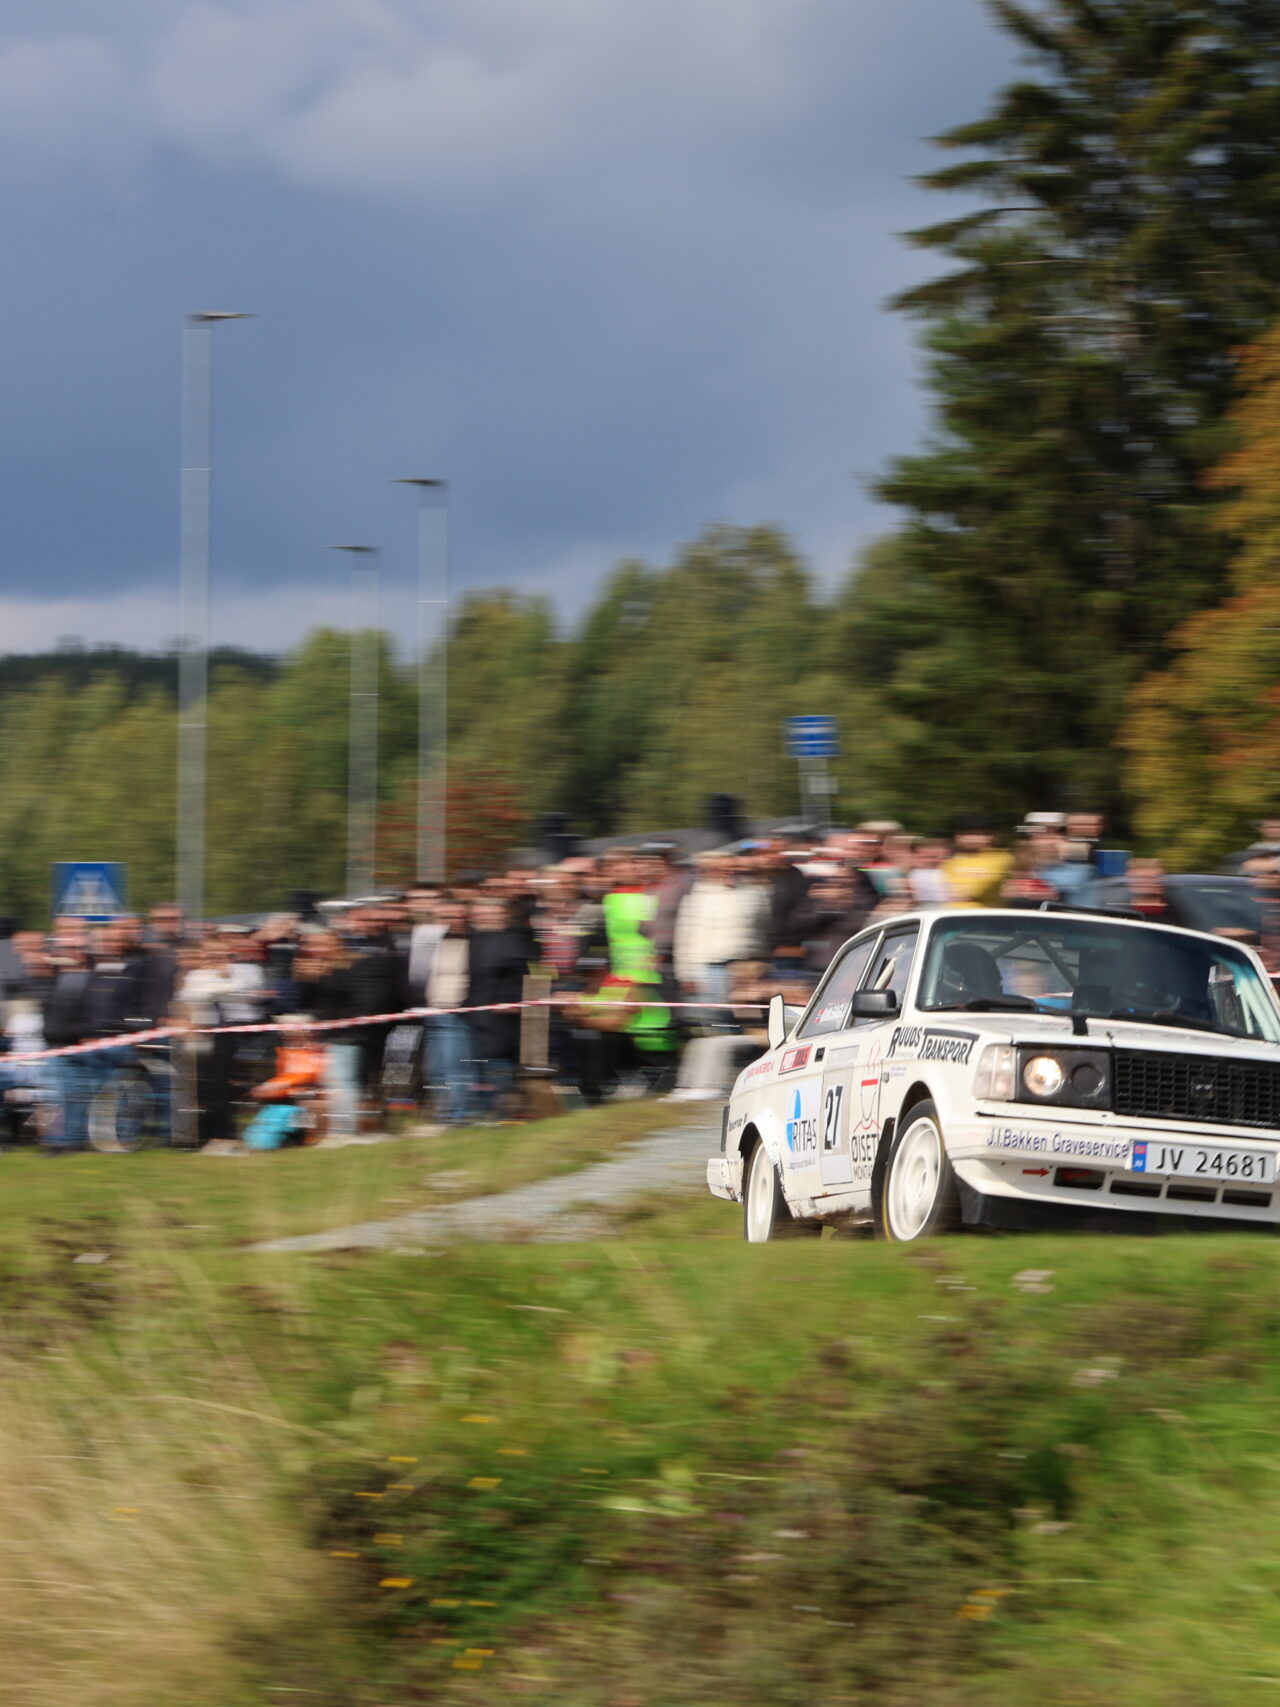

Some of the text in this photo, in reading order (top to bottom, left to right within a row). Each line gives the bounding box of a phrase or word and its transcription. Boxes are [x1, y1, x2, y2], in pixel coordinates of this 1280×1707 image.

[886, 1027, 980, 1065] RUUDS TRANSPORT
[824, 1085, 843, 1150] 27
[792, 1118, 817, 1153] RITAS
[1052, 1132, 1130, 1159] Graveservice
[1156, 1147, 1267, 1179] JV 24681
